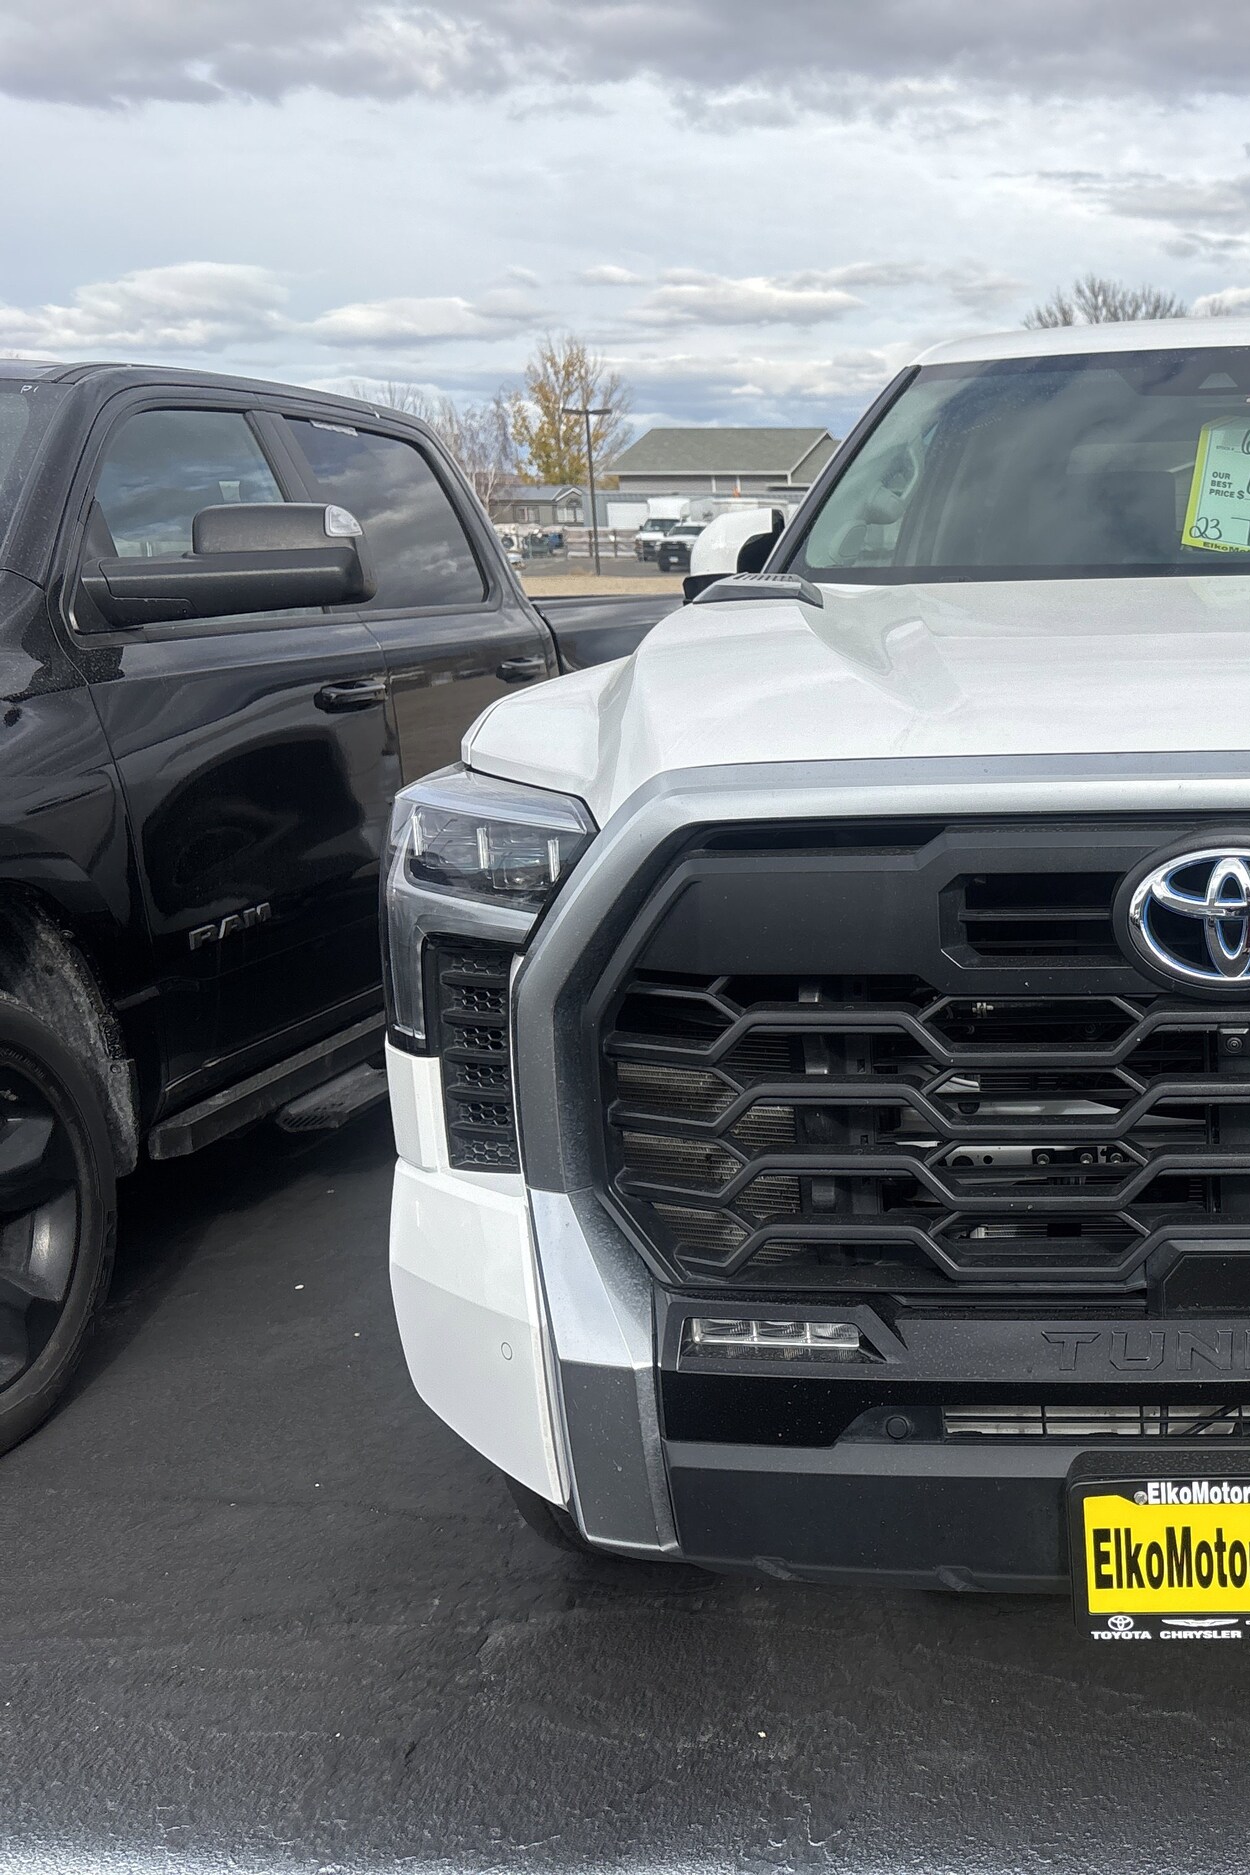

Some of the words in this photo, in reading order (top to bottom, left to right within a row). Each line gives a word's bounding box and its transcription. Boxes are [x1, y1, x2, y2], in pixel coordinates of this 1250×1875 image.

[1211, 471, 1231, 480] OUR
[1210, 480, 1234, 489] BEST
[1208, 488, 1235, 499] PRICE
[1189, 516, 1223, 540] 23
[189, 902, 272, 951] RAM
[1091, 1631, 1152, 1640] TOYOTA
[1159, 1630, 1242, 1640] CHRYSLER
